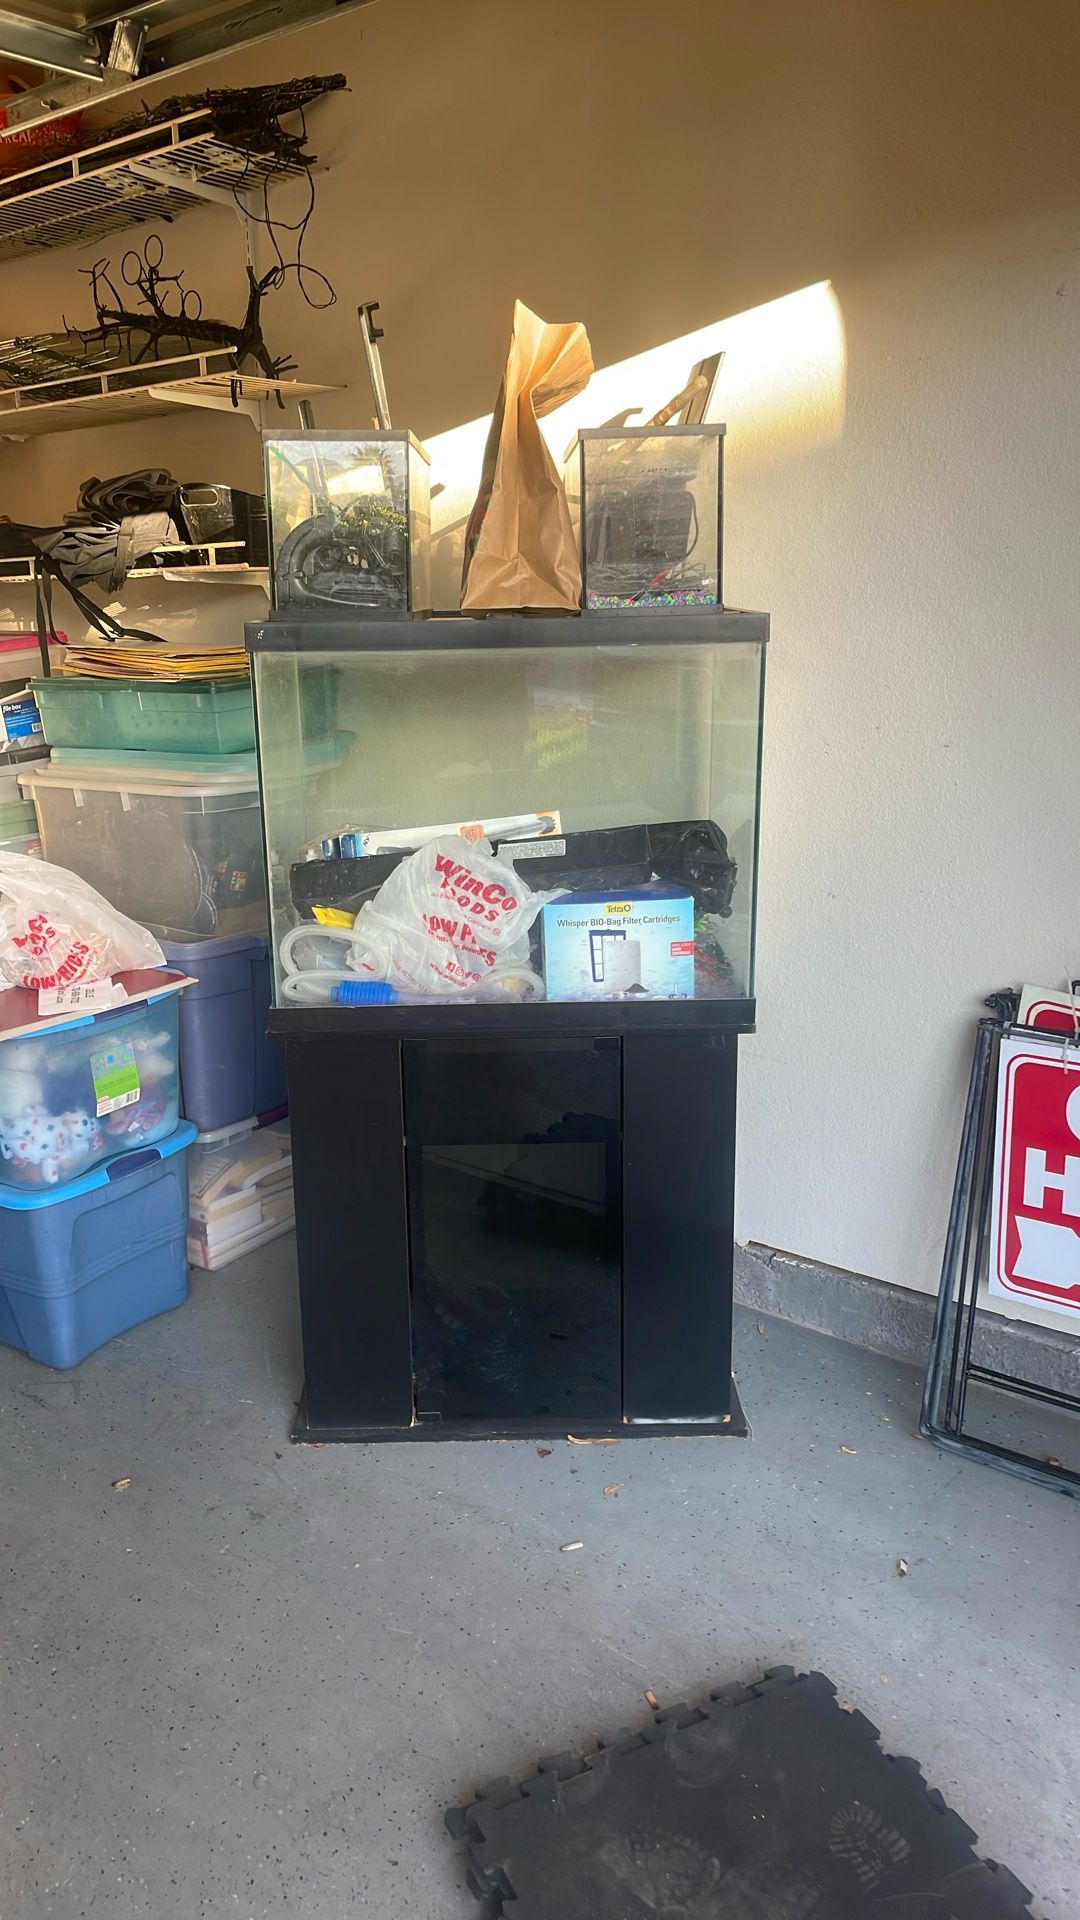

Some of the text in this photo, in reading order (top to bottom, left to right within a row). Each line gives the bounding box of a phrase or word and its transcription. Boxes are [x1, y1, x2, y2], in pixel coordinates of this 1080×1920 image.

[434, 853, 518, 912] WinCo
[557, 918, 589, 929] Whisper
[590, 917, 622, 927] BIO-Bag
[642, 914, 681, 925] Cartridges
